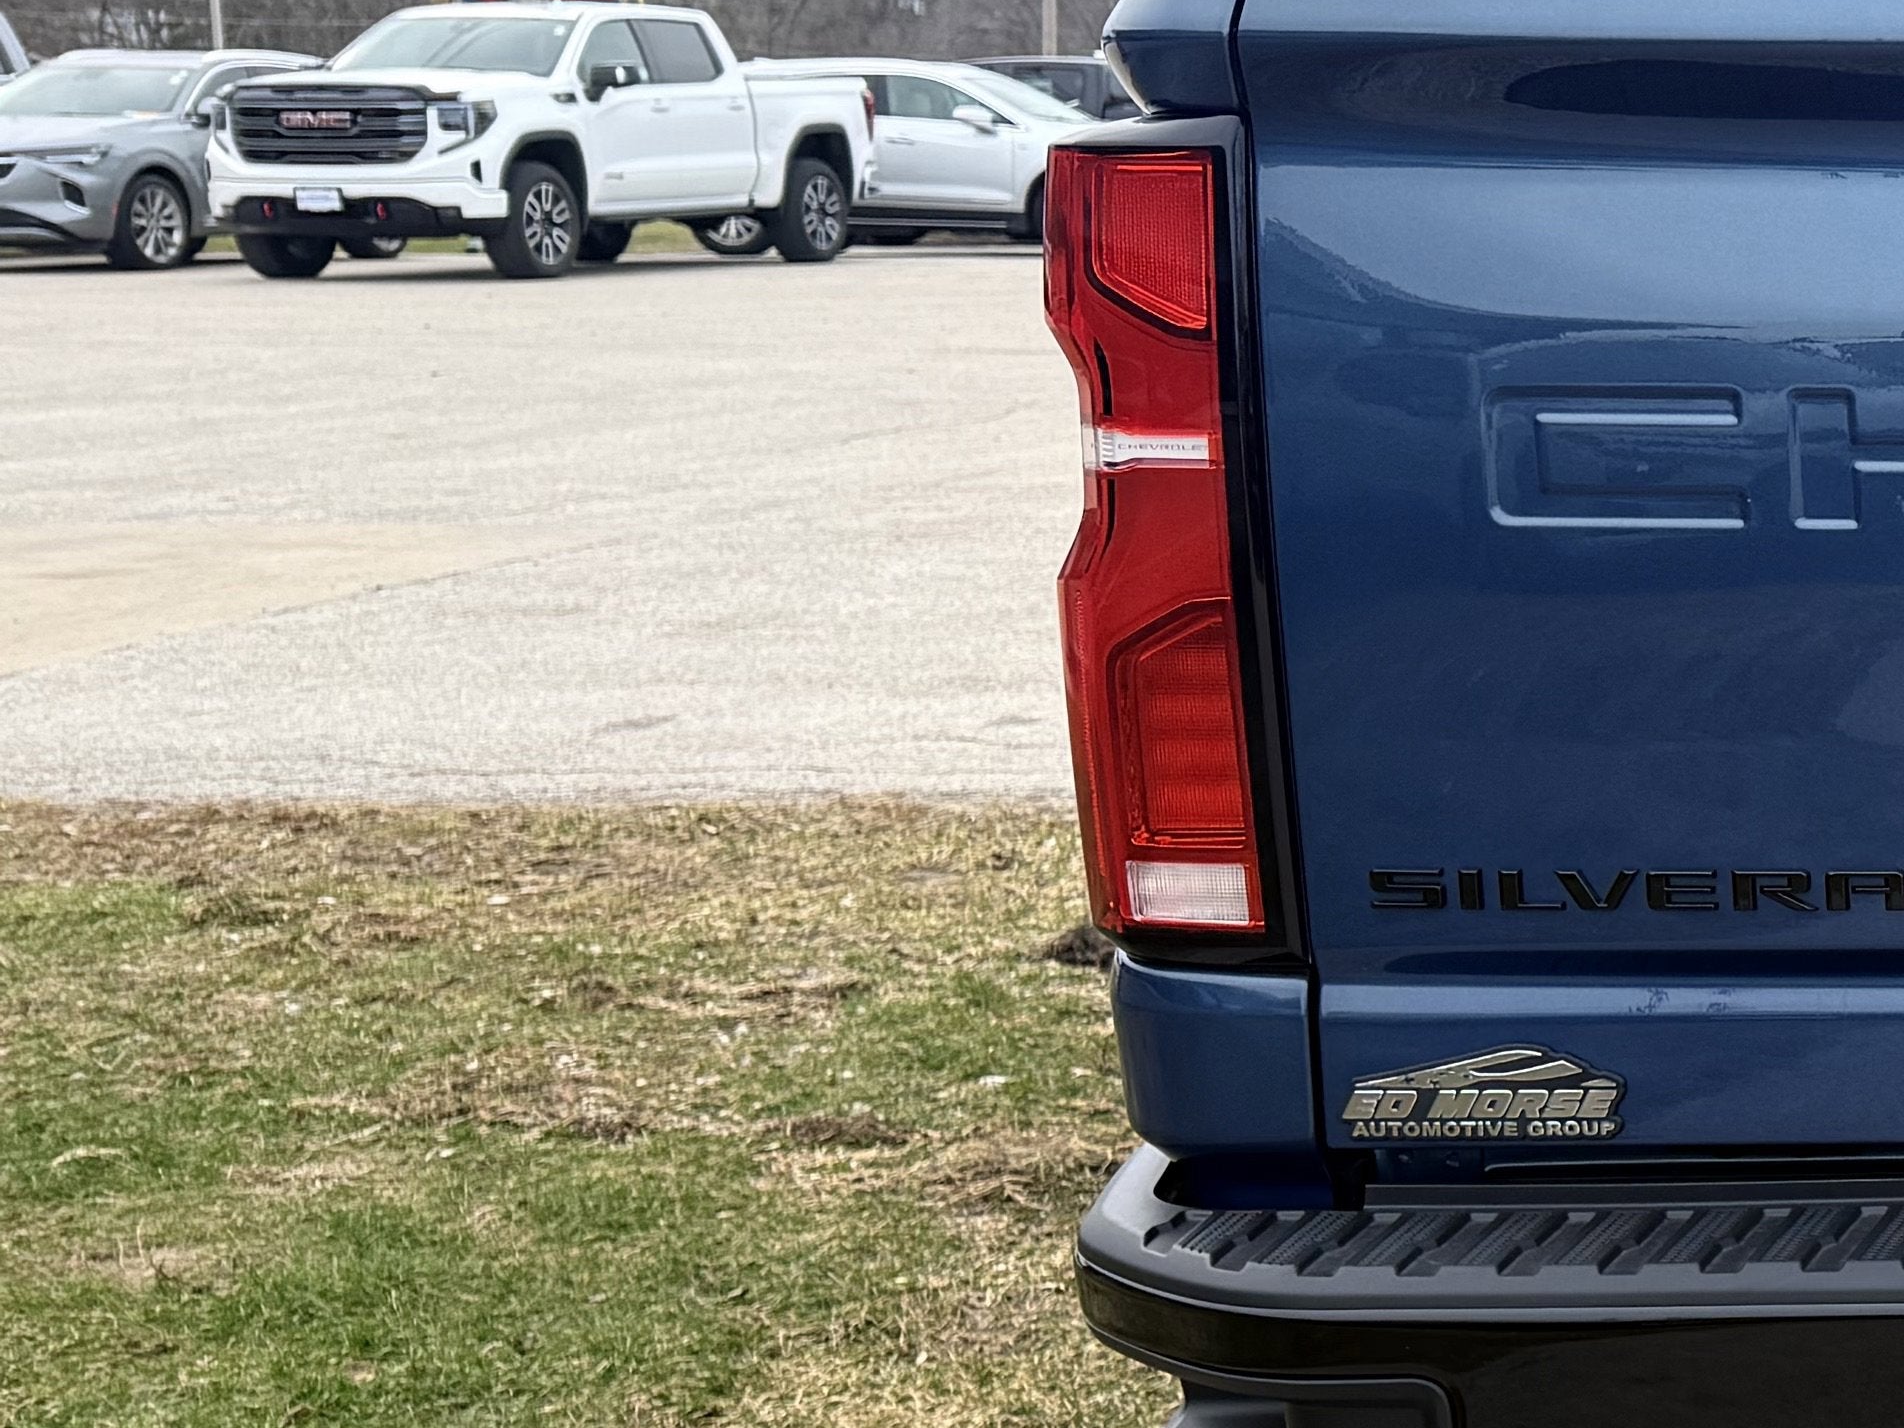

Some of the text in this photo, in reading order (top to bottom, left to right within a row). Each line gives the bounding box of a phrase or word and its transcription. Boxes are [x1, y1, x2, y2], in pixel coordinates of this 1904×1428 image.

[1342, 1089, 1617, 1119] ED MORSE
[1352, 1120, 1616, 1138] AUTOMOTIVE GROUP
